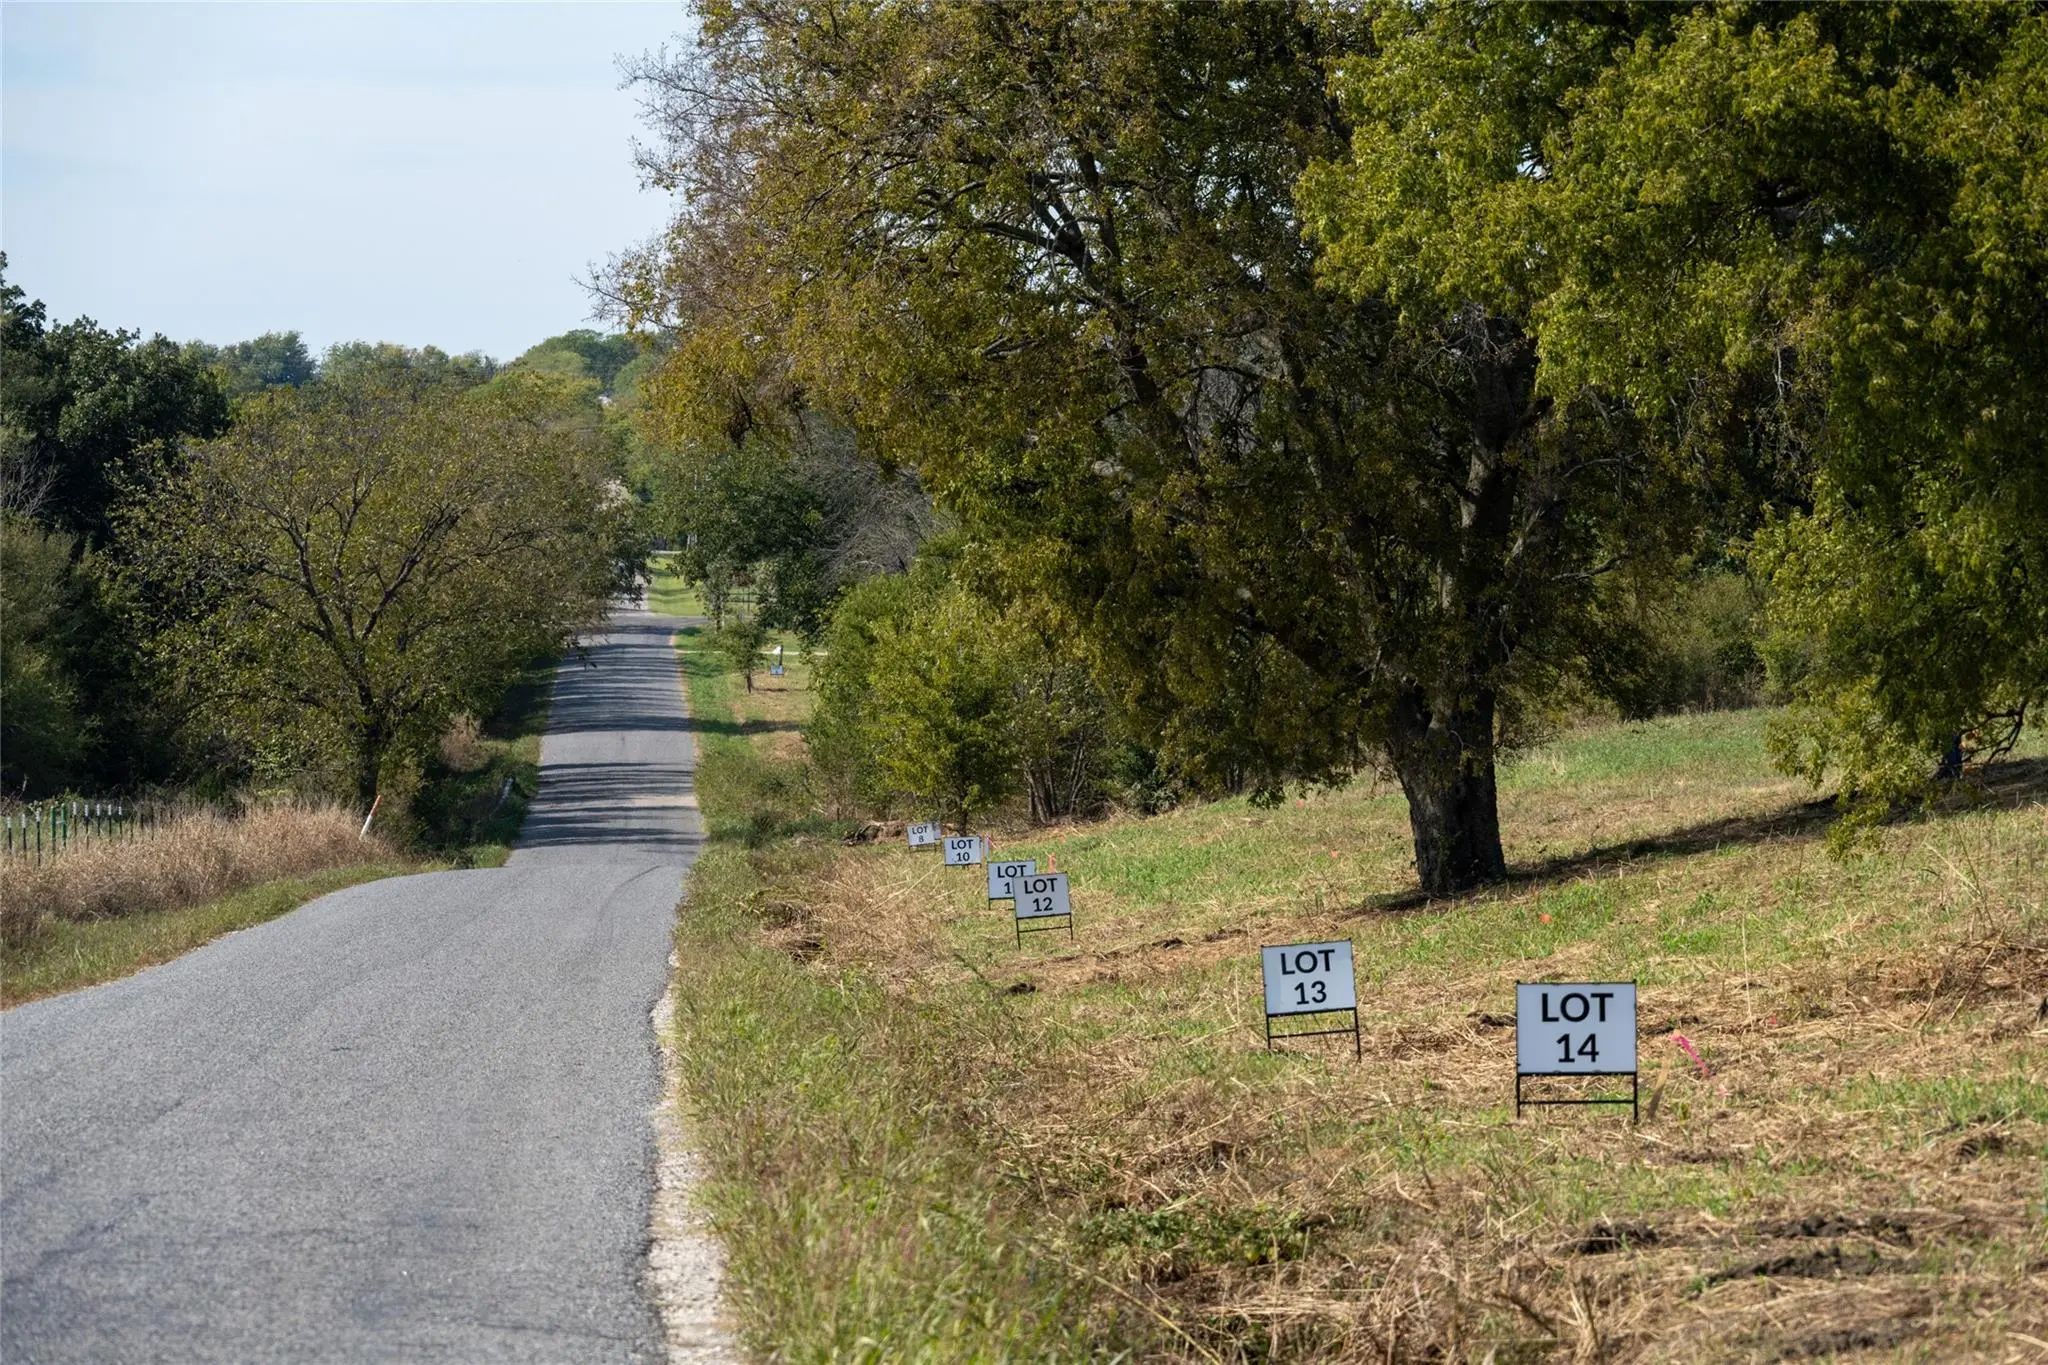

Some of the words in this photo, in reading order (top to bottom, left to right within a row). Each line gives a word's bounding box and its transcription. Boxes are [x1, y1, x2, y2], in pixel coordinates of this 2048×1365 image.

[912, 826, 928, 835] LOT
[951, 839, 974, 850] LOT
[957, 851, 970, 862] 10
[997, 864, 1027, 878] LOT
[1004, 882, 1012, 894] 1
[1024, 878, 1058, 894] LOT
[1032, 896, 1053, 912] 12
[1280, 948, 1336, 976] LOT
[1294, 980, 1327, 1005] 13
[1541, 992, 1614, 1023] LOT
[1556, 1033, 1600, 1063] 14
